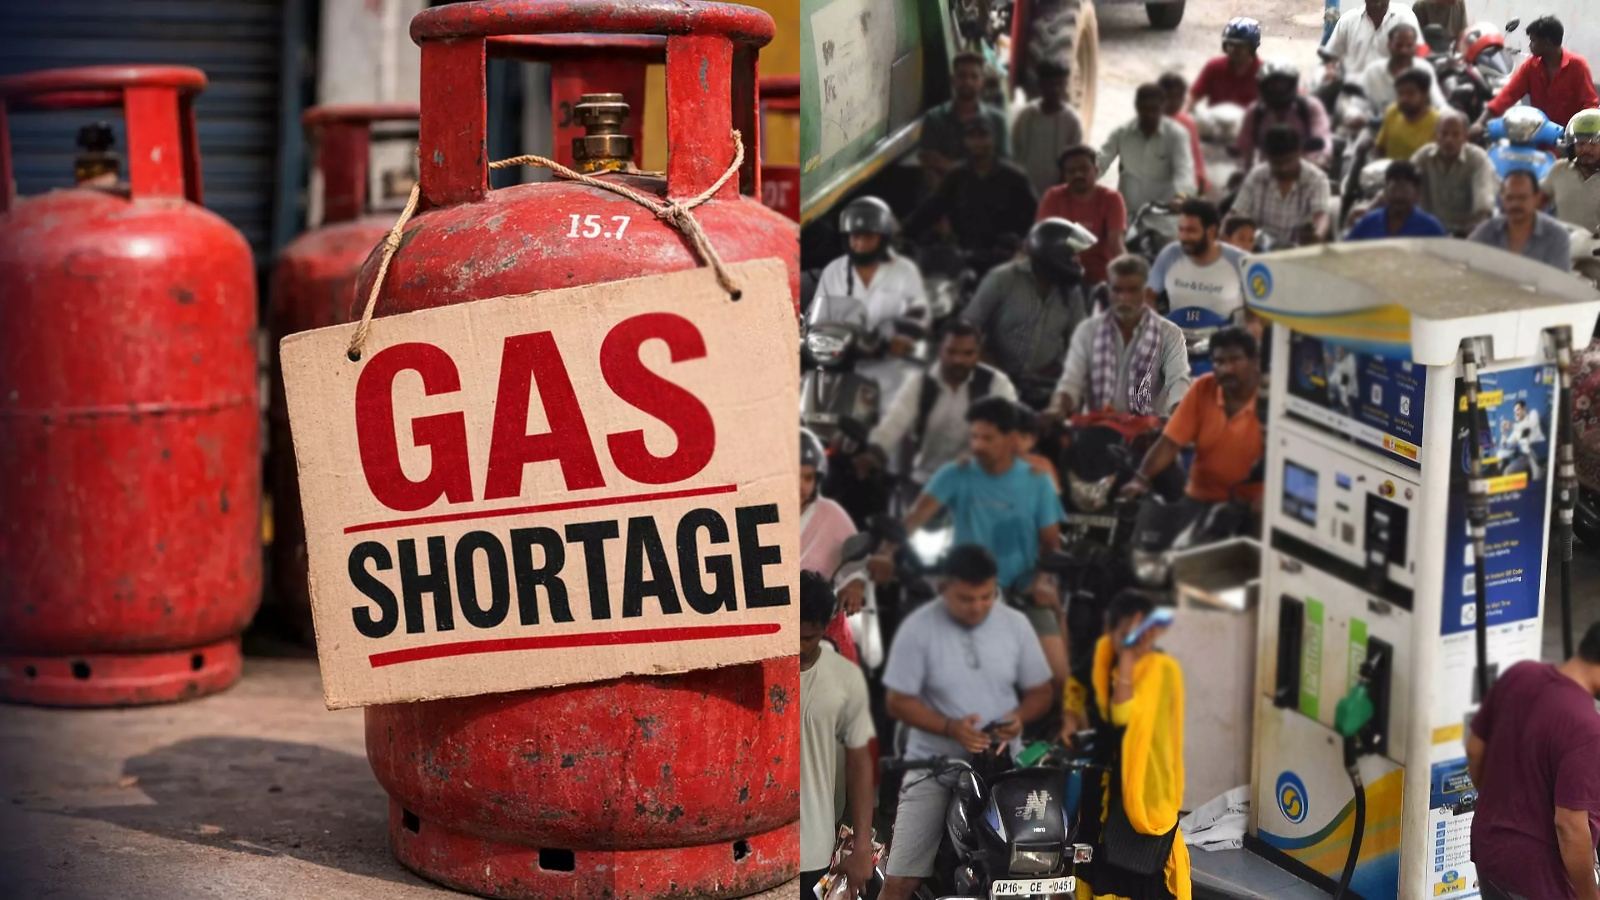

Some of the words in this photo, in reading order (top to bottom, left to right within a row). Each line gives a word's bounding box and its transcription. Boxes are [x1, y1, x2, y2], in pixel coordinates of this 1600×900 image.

[566, 213, 631, 240] 15.7
[355, 312, 716, 512] GAS
[348, 503, 791, 639] SHORTAGE
[1030, 881, 1042, 892] CE
[1441, 884, 1459, 894] ATM
